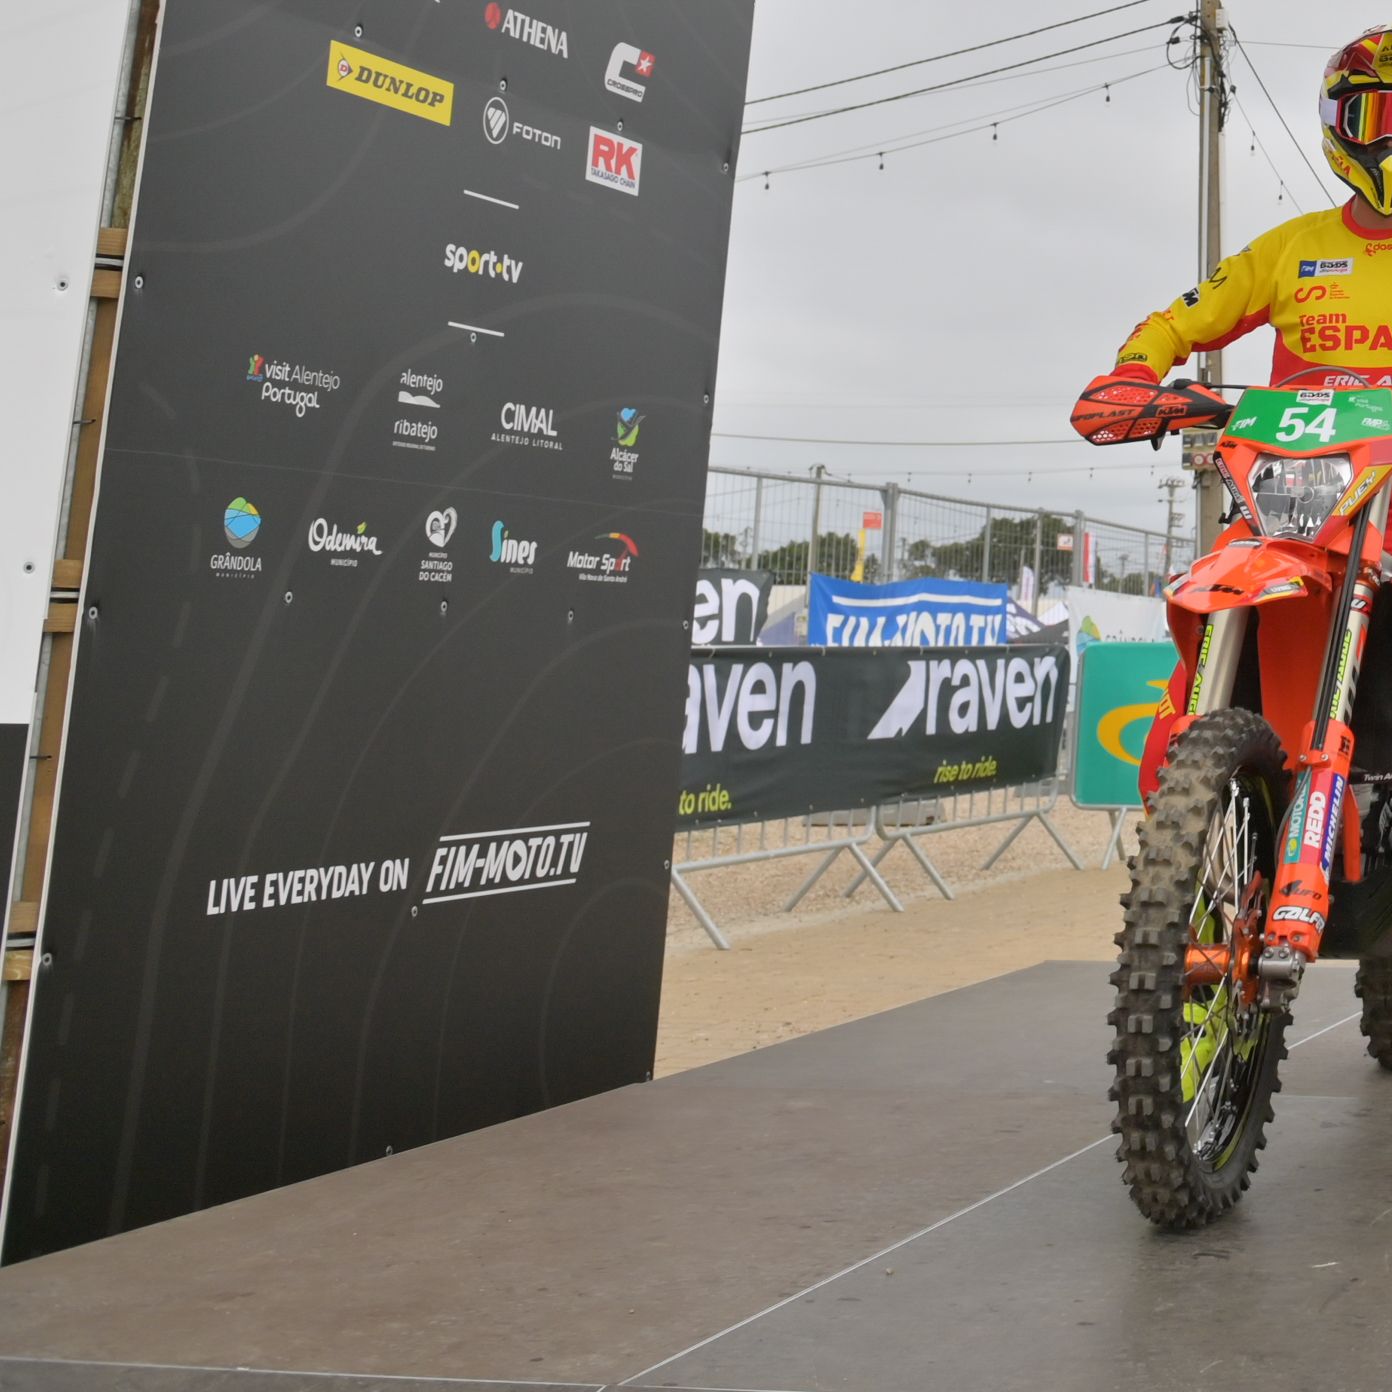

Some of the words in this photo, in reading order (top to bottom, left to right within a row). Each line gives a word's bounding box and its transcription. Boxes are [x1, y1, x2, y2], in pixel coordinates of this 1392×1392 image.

[501, 9, 568, 58] ATHENA
[355, 65, 444, 107] DUNLOP
[606, 78, 643, 98] CROSSPRO
[513, 122, 561, 149] FOTON
[591, 133, 638, 181] RK
[1299, 313, 1347, 328] Team
[265, 360, 290, 381] visit
[291, 365, 340, 391] Alentejo
[400, 369, 443, 395] alentejo
[262, 382, 320, 417] Portugal
[394, 419, 438, 442] ribatejo
[501, 402, 558, 436] CIMAL
[1275, 407, 1338, 443] 54
[491, 433, 529, 446] ALENTEJO
[532, 439, 563, 451] LITORAL
[610, 447, 640, 463] Alcácer
[623, 461, 634, 473] Sal
[308, 518, 383, 555] Odemira
[490, 520, 537, 565] Sines
[210, 552, 262, 572] GRÂNDOLA
[421, 560, 453, 571] SANTIAGO
[567, 551, 597, 570] Motor
[600, 553, 631, 574] Sport
[419, 571, 429, 581] DO
[683, 660, 817, 755] ven
[926, 655, 1058, 736] raven
[934, 762, 959, 784] rise
[960, 763, 973, 784] to
[678, 793, 696, 815] to
[1304, 791, 1327, 848] REDD
[206, 876, 258, 915] LIVE
[262, 861, 375, 908] EVERYDAY
[379, 858, 410, 892] ON
[426, 832, 588, 892] FIM-MOTO.TV
